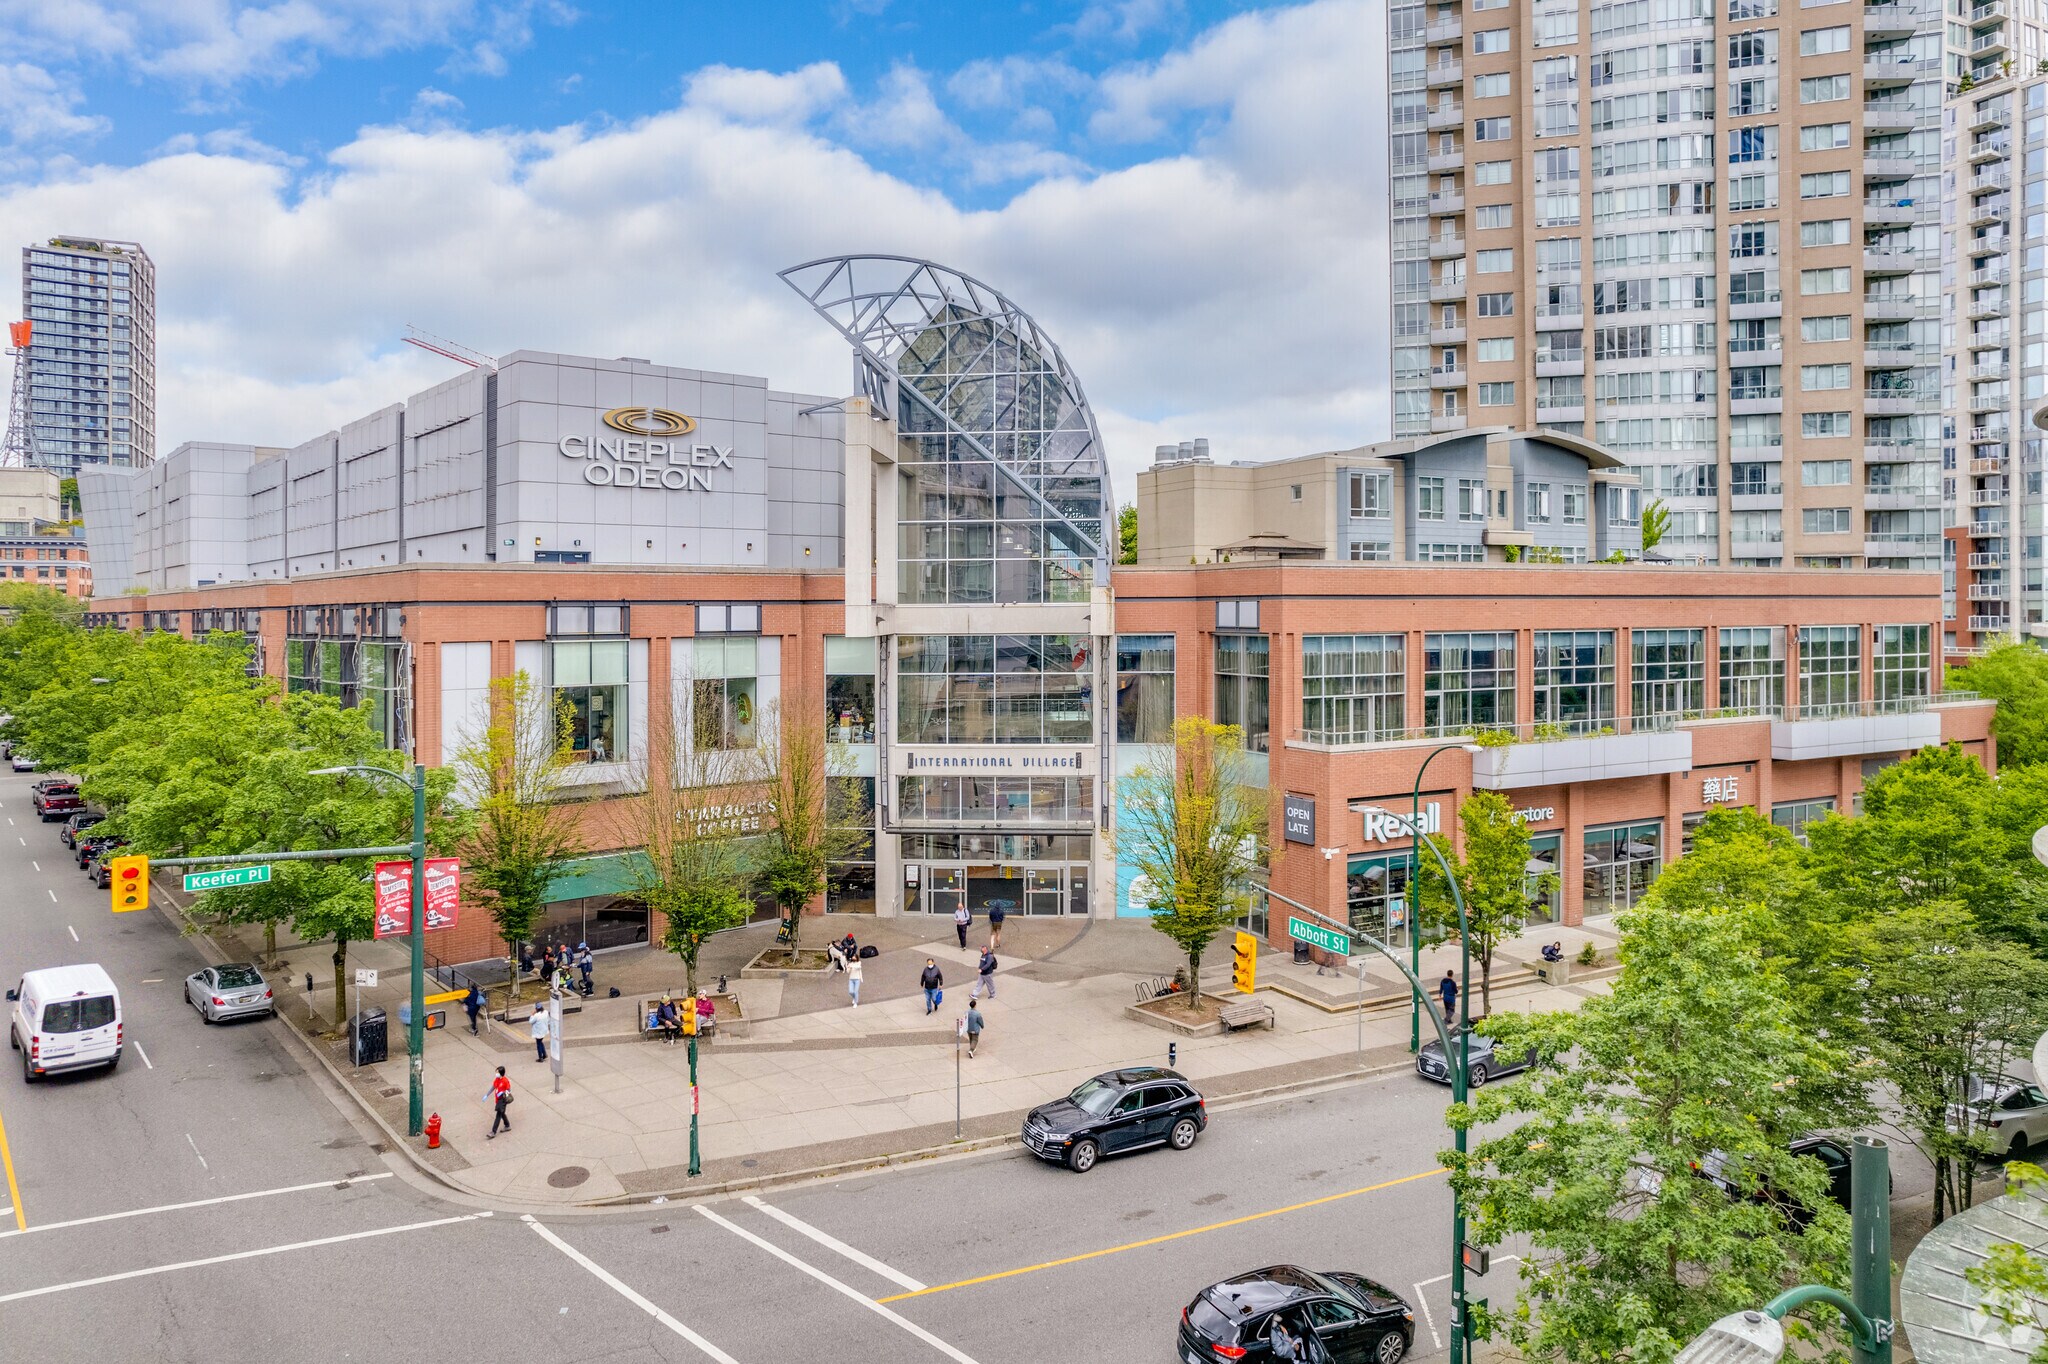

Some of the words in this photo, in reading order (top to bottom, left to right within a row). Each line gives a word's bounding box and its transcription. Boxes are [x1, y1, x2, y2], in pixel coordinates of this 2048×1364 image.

[559, 434, 733, 469] CINEPLEX
[584, 462, 712, 491] ODEON
[915, 757, 1012, 767] INTERNATIONAL
[1023, 757, 1074, 767] VILLAGE
[1703, 775, 1738, 803] 藥店
[676, 800, 777, 823] STARBUCKS
[1287, 807, 1310, 820] OPEN
[1364, 802, 1440, 843] Rexall
[1288, 822, 1309, 835] LATE
[191, 872, 242, 888] Keefer
[248, 868, 263, 880] Pl
[430, 877, 454, 890] DEMYSTIFY
[1293, 922, 1329, 946] Abbott
[1333, 936, 1345, 952] St
